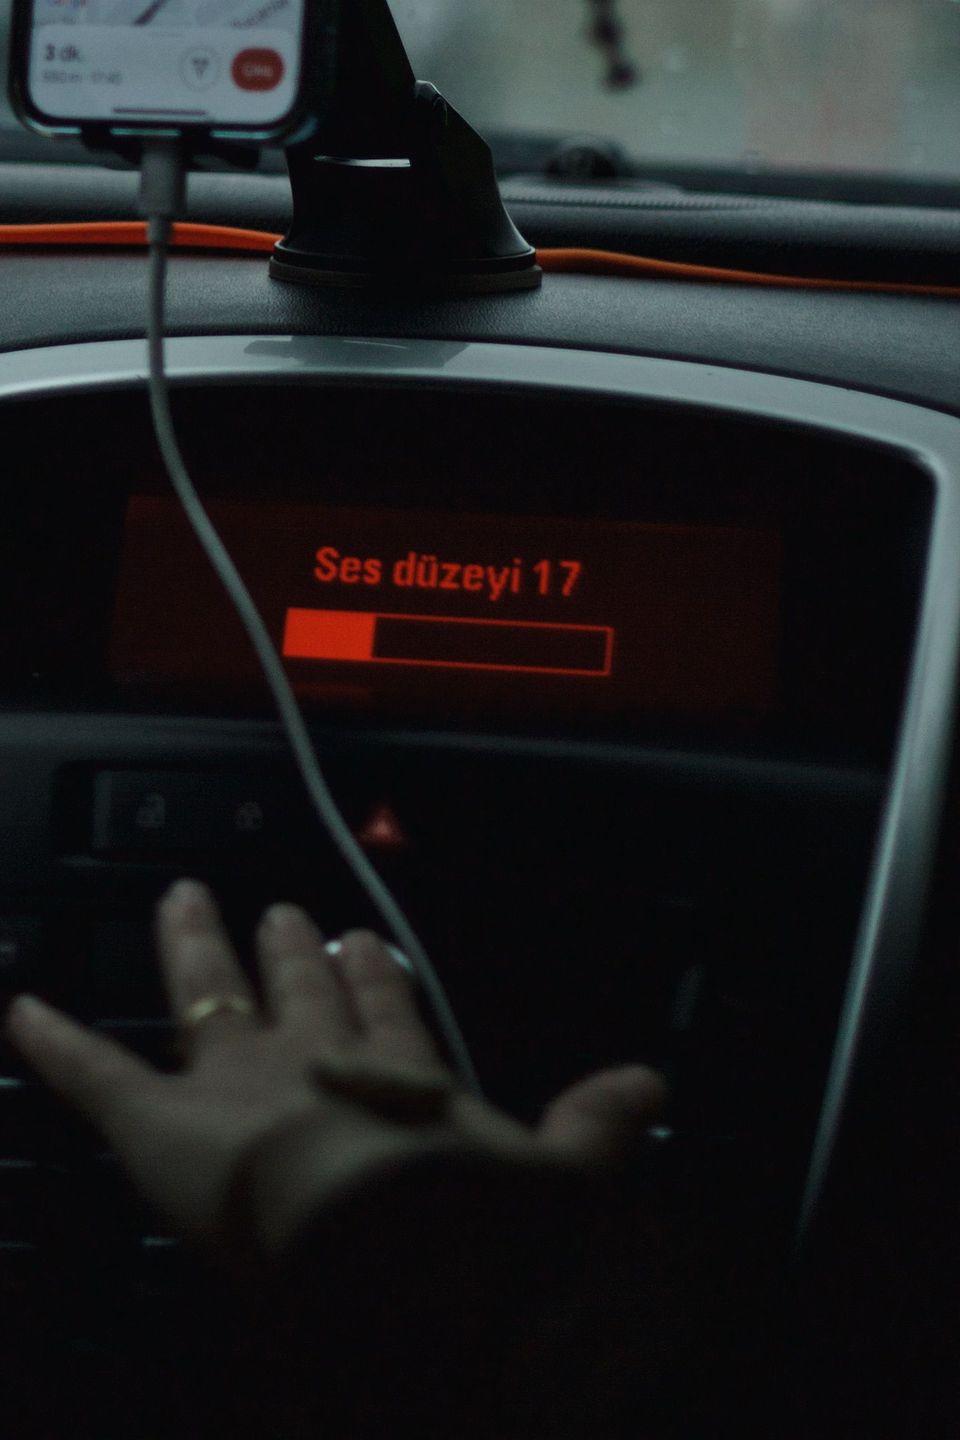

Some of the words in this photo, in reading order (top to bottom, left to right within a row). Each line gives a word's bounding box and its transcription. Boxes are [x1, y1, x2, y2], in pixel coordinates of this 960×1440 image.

[314, 546, 382, 584] Ses
[393, 551, 522, 601] düzeyi
[534, 560, 582, 596] 17
